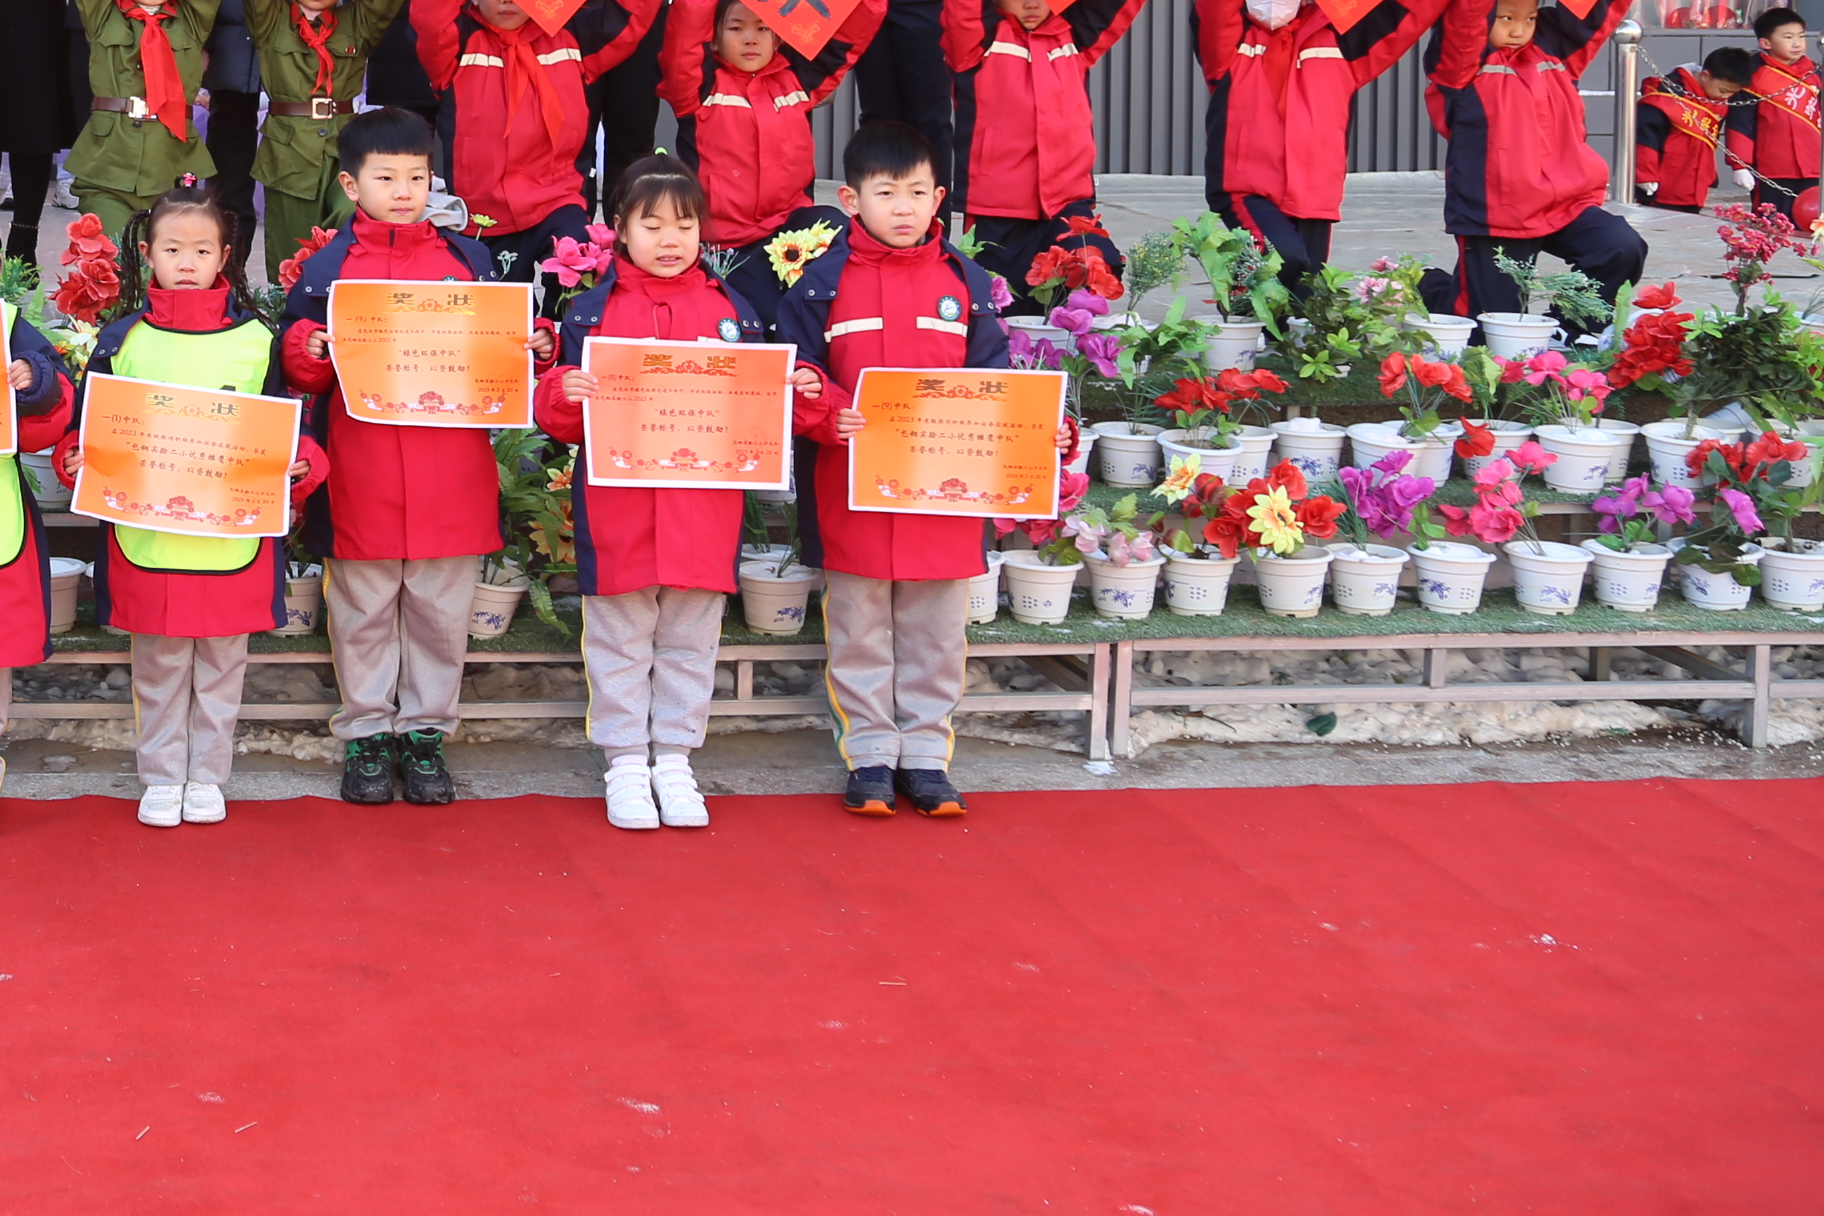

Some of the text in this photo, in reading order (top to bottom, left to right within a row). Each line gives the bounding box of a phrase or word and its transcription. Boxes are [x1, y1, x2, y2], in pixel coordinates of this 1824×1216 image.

[386, 292, 475, 307] 奖状
[642, 354, 737, 369] 奖状
[915, 379, 1008, 394] 奖状
[145, 394, 241, 416] 奖状
